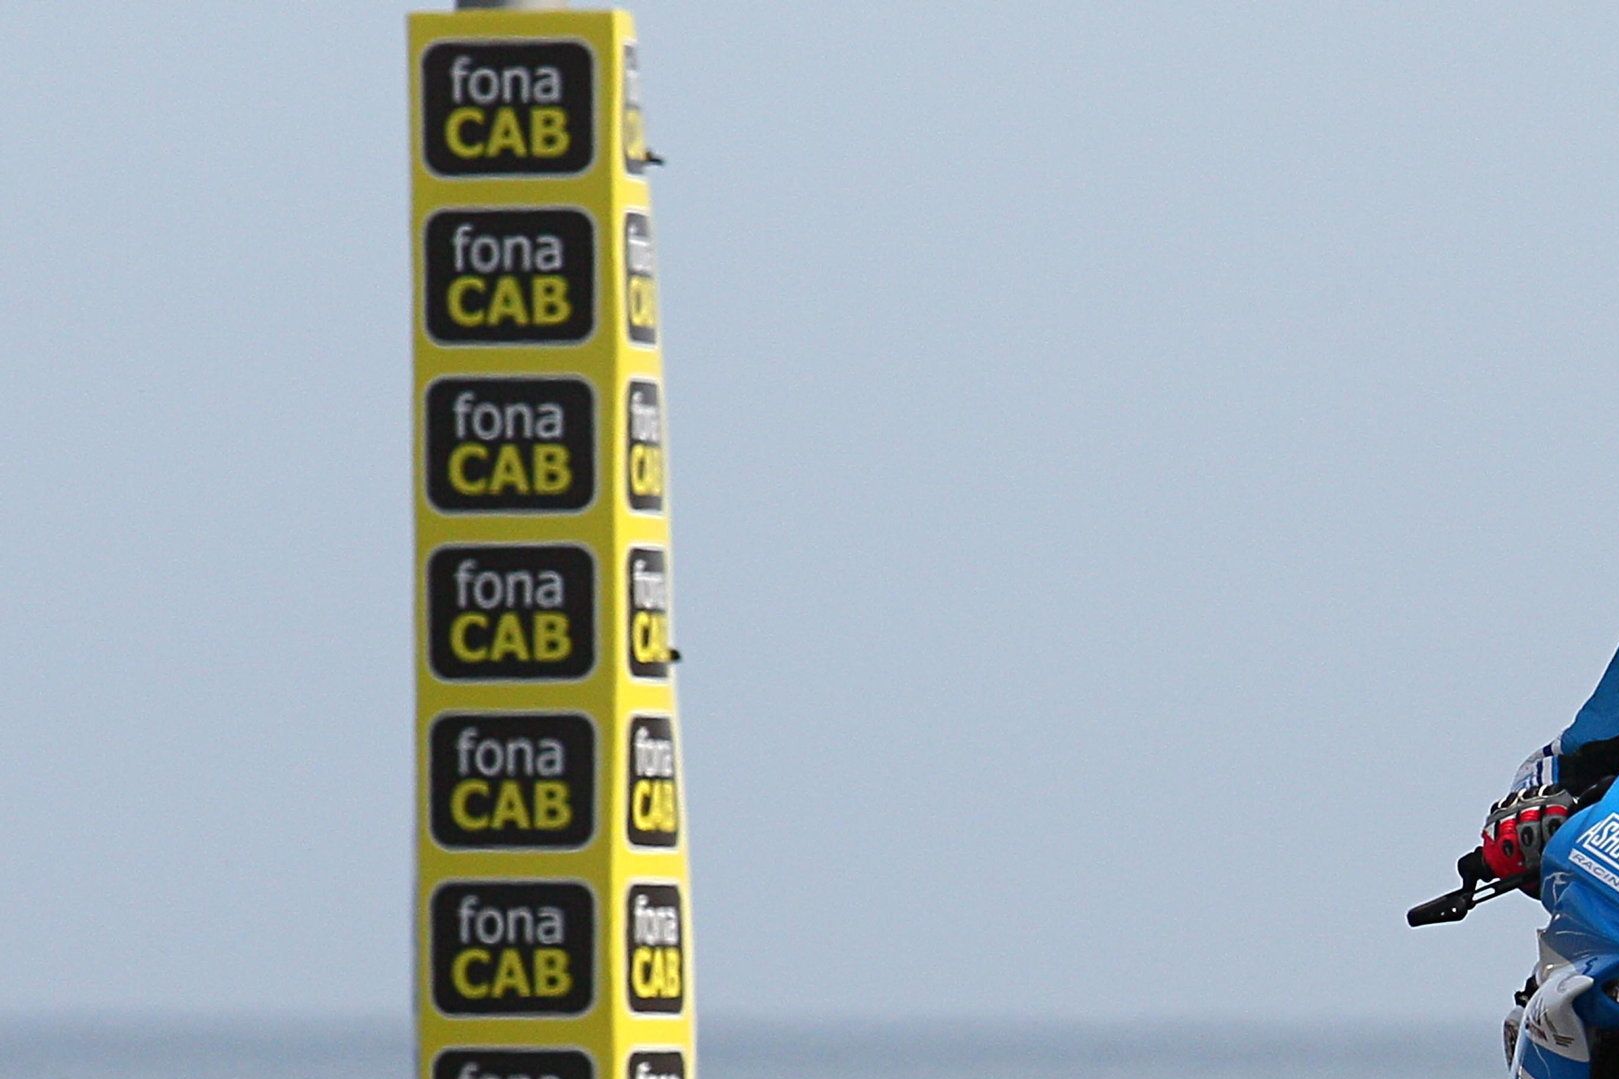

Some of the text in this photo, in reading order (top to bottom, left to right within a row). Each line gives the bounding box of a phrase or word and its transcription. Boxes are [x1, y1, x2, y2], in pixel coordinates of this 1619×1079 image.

[450, 56, 561, 103] fona
[444, 106, 571, 159] CAB
[453, 225, 563, 273] fona
[446, 276, 572, 327] CAB
[453, 393, 564, 441] fona
[448, 443, 573, 496] CAB
[454, 560, 564, 609] fona
[449, 612, 572, 664] CAB
[457, 727, 565, 777] fona
[449, 779, 573, 831] CAB
[458, 895, 565, 945] fona
[451, 947, 573, 998] CAB
[632, 945, 682, 998] CAB
